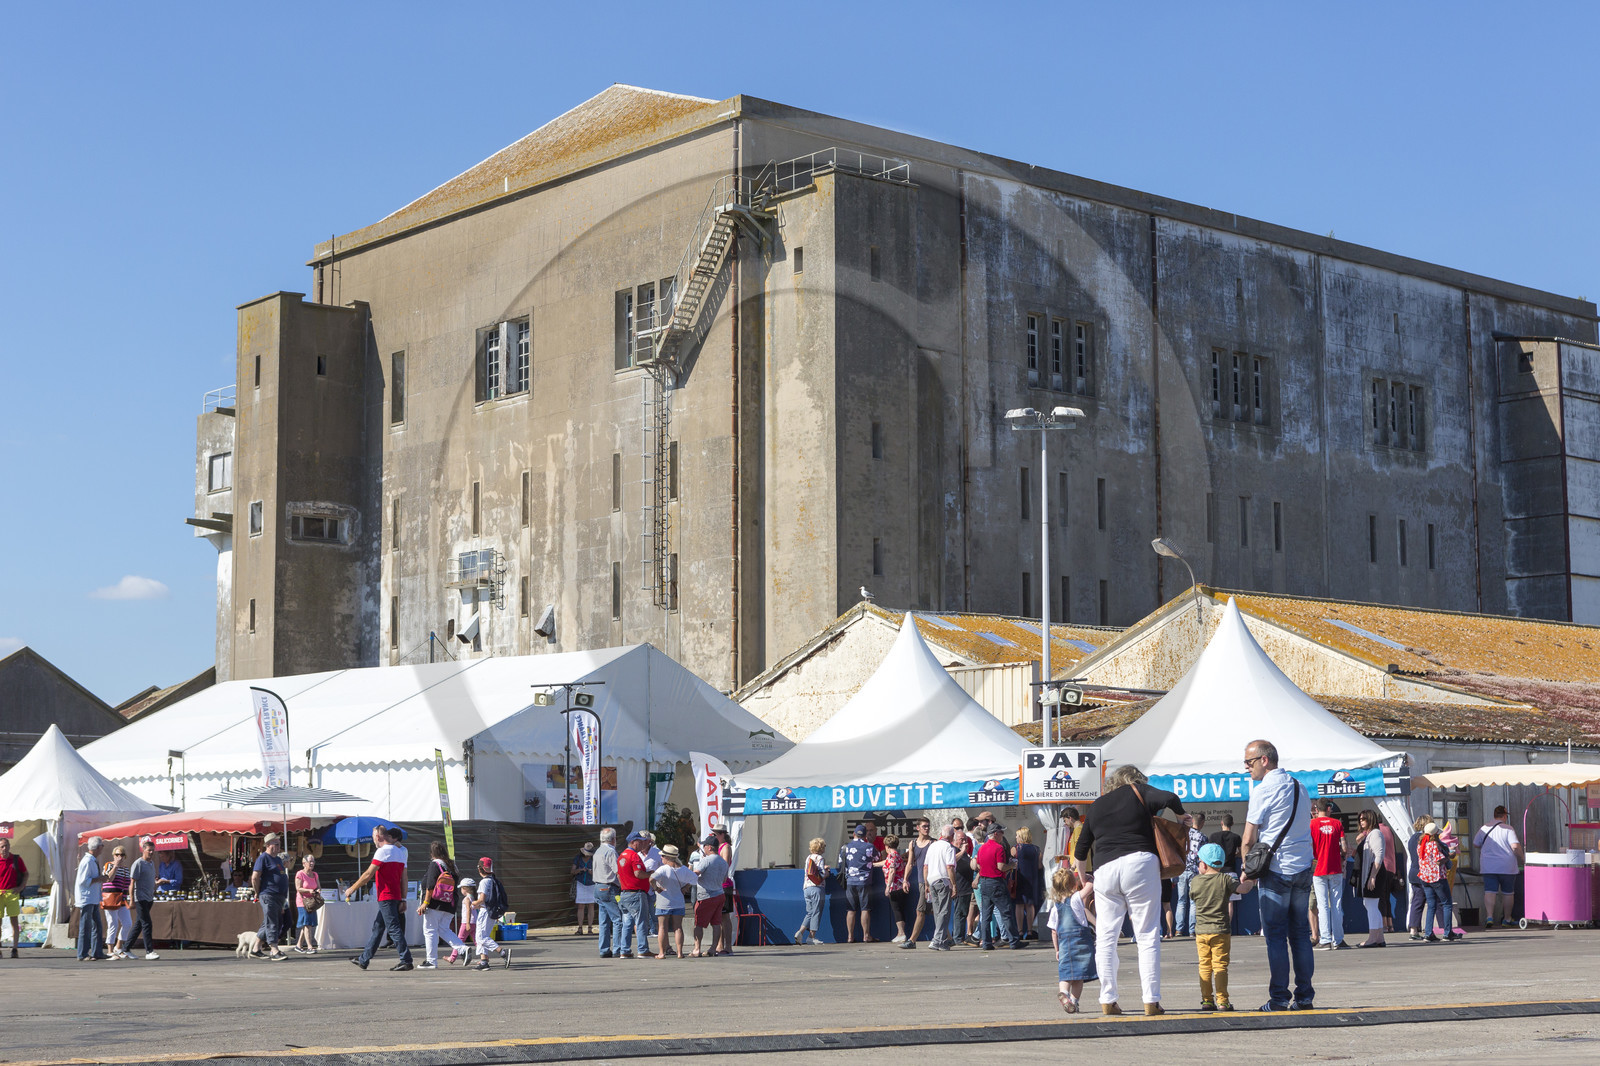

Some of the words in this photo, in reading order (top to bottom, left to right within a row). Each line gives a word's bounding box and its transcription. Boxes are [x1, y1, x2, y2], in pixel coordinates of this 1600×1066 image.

[1026, 752, 1097, 769] BAR
[1050, 781, 1074, 789] Britt
[1173, 777, 1254, 799] BUVET
[1326, 783, 1357, 794] Britt
[705, 763, 719, 830] JATO
[832, 784, 944, 808] BUVETTE
[977, 792, 1007, 803] Britt
[769, 800, 799, 810] Britt
[876, 821, 909, 837] ritt
[155, 836, 184, 845] SALICORNES
